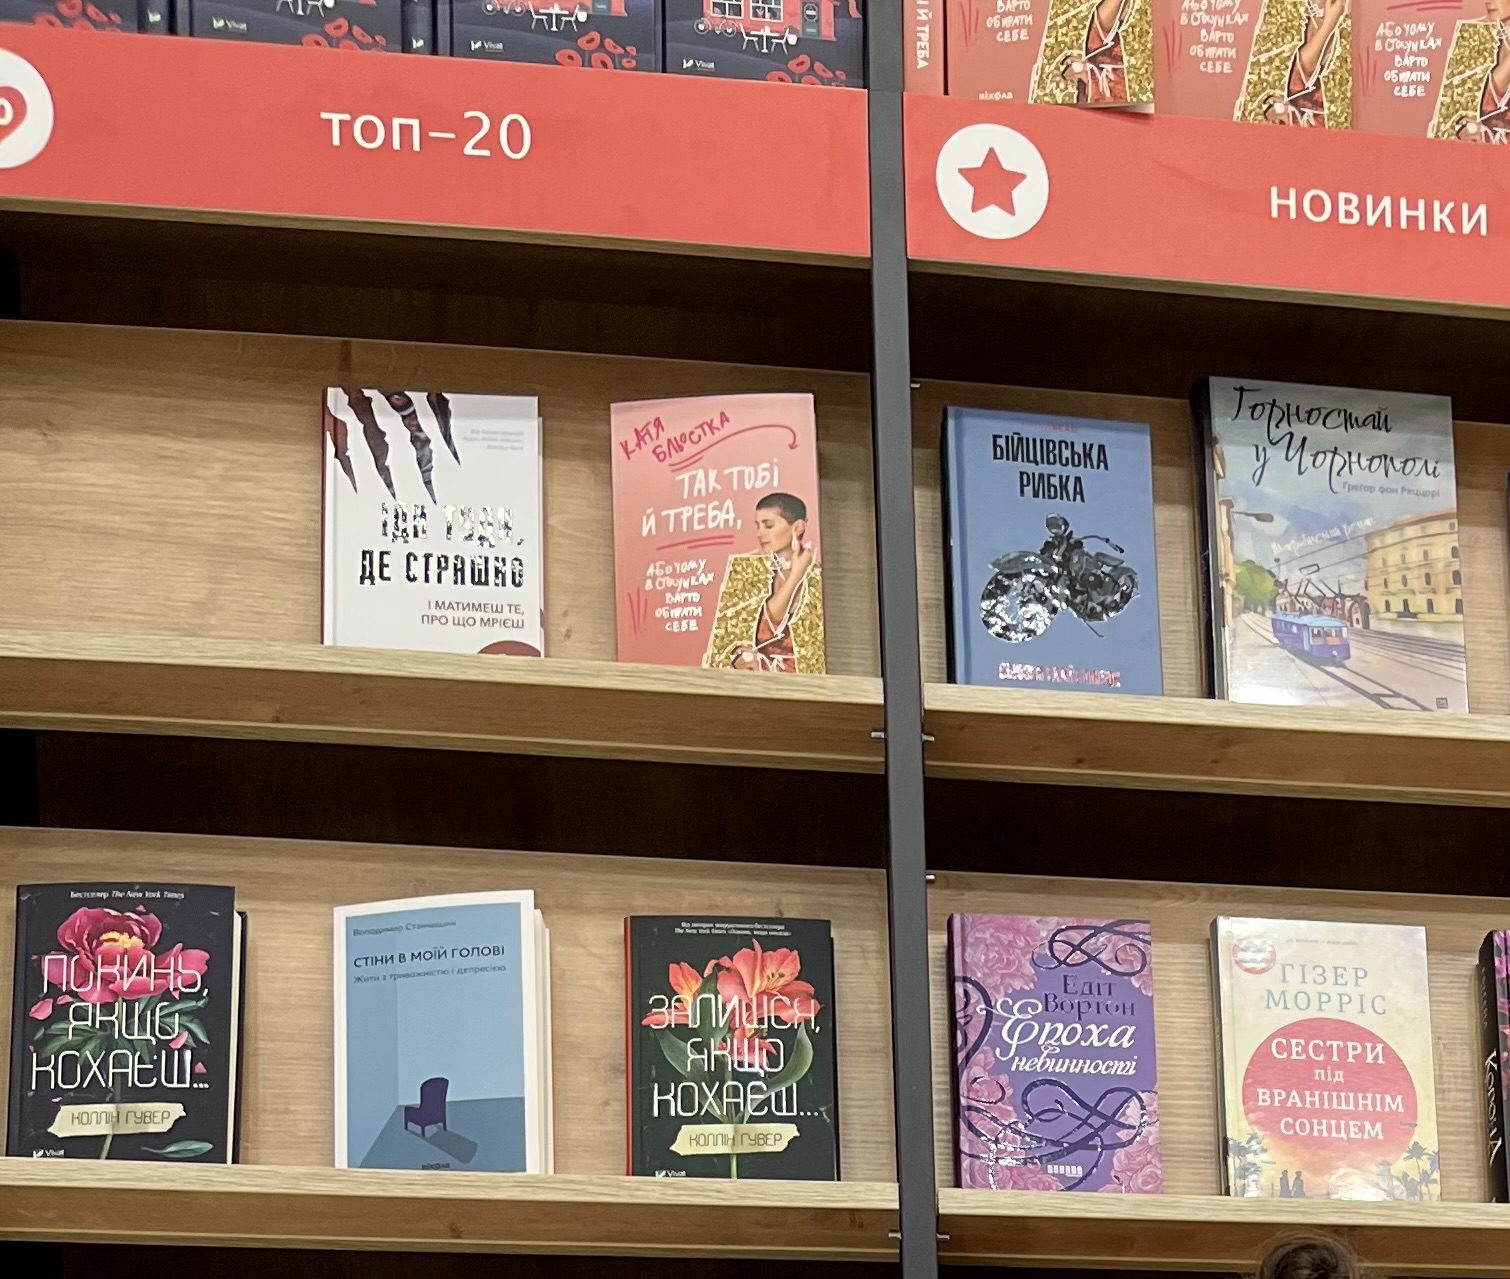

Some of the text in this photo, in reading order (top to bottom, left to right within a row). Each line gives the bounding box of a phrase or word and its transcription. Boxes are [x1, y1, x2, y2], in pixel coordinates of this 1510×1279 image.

[1393, 84, 1426, 98] СЕБЕ
[619, 415, 665, 460] КАТЯ
[991, 431, 1110, 472] БІЙЦІВСЬКА
[675, 458, 779, 499] ТАК ТОБІ
[1018, 470, 1086, 503] РИБКА
[661, 498, 743, 534] ТРЕБА,
[359, 549, 525, 588] ДЕ СТРАШНО
[435, 601, 504, 615] МАТИМЕШ
[507, 604, 525, 616] ТЕ,
[421, 615, 525, 630] ПРО ЩО МРІЄШ
[664, 619, 699, 632] СЕБЕ
[353, 945, 505, 969] СТІНИ В МОЇЙ ГОЛОВІ
[43, 954, 208, 997] ПОКИНЬ,
[1063, 975, 1117, 998] Едіт
[1279, 963, 1369, 988] ГІЗЕР
[648, 993, 820, 1035] ЗАЛИШСЯ,
[1044, 993, 1135, 1021] Вортон
[1265, 989, 1387, 1016] МОРРІС
[68, 1001, 180, 1046] ЯКЩО
[977, 998, 1137, 1061] Епоха
[687, 1037, 784, 1077] ЯКЩО
[1011, 1046, 1138, 1076] невинності
[1271, 1037, 1386, 1064] СЕСТРИ
[1314, 1066, 1345, 1083] під
[1256, 1088, 1404, 1113] ВРАНІШНІМ
[71, 1110, 171, 1126] КОЛЛІН ГУВЕР
[1280, 1117, 1384, 1141] СОНЦЕМ
[689, 1132, 783, 1147] КОЛЛІН ГУВЕР
